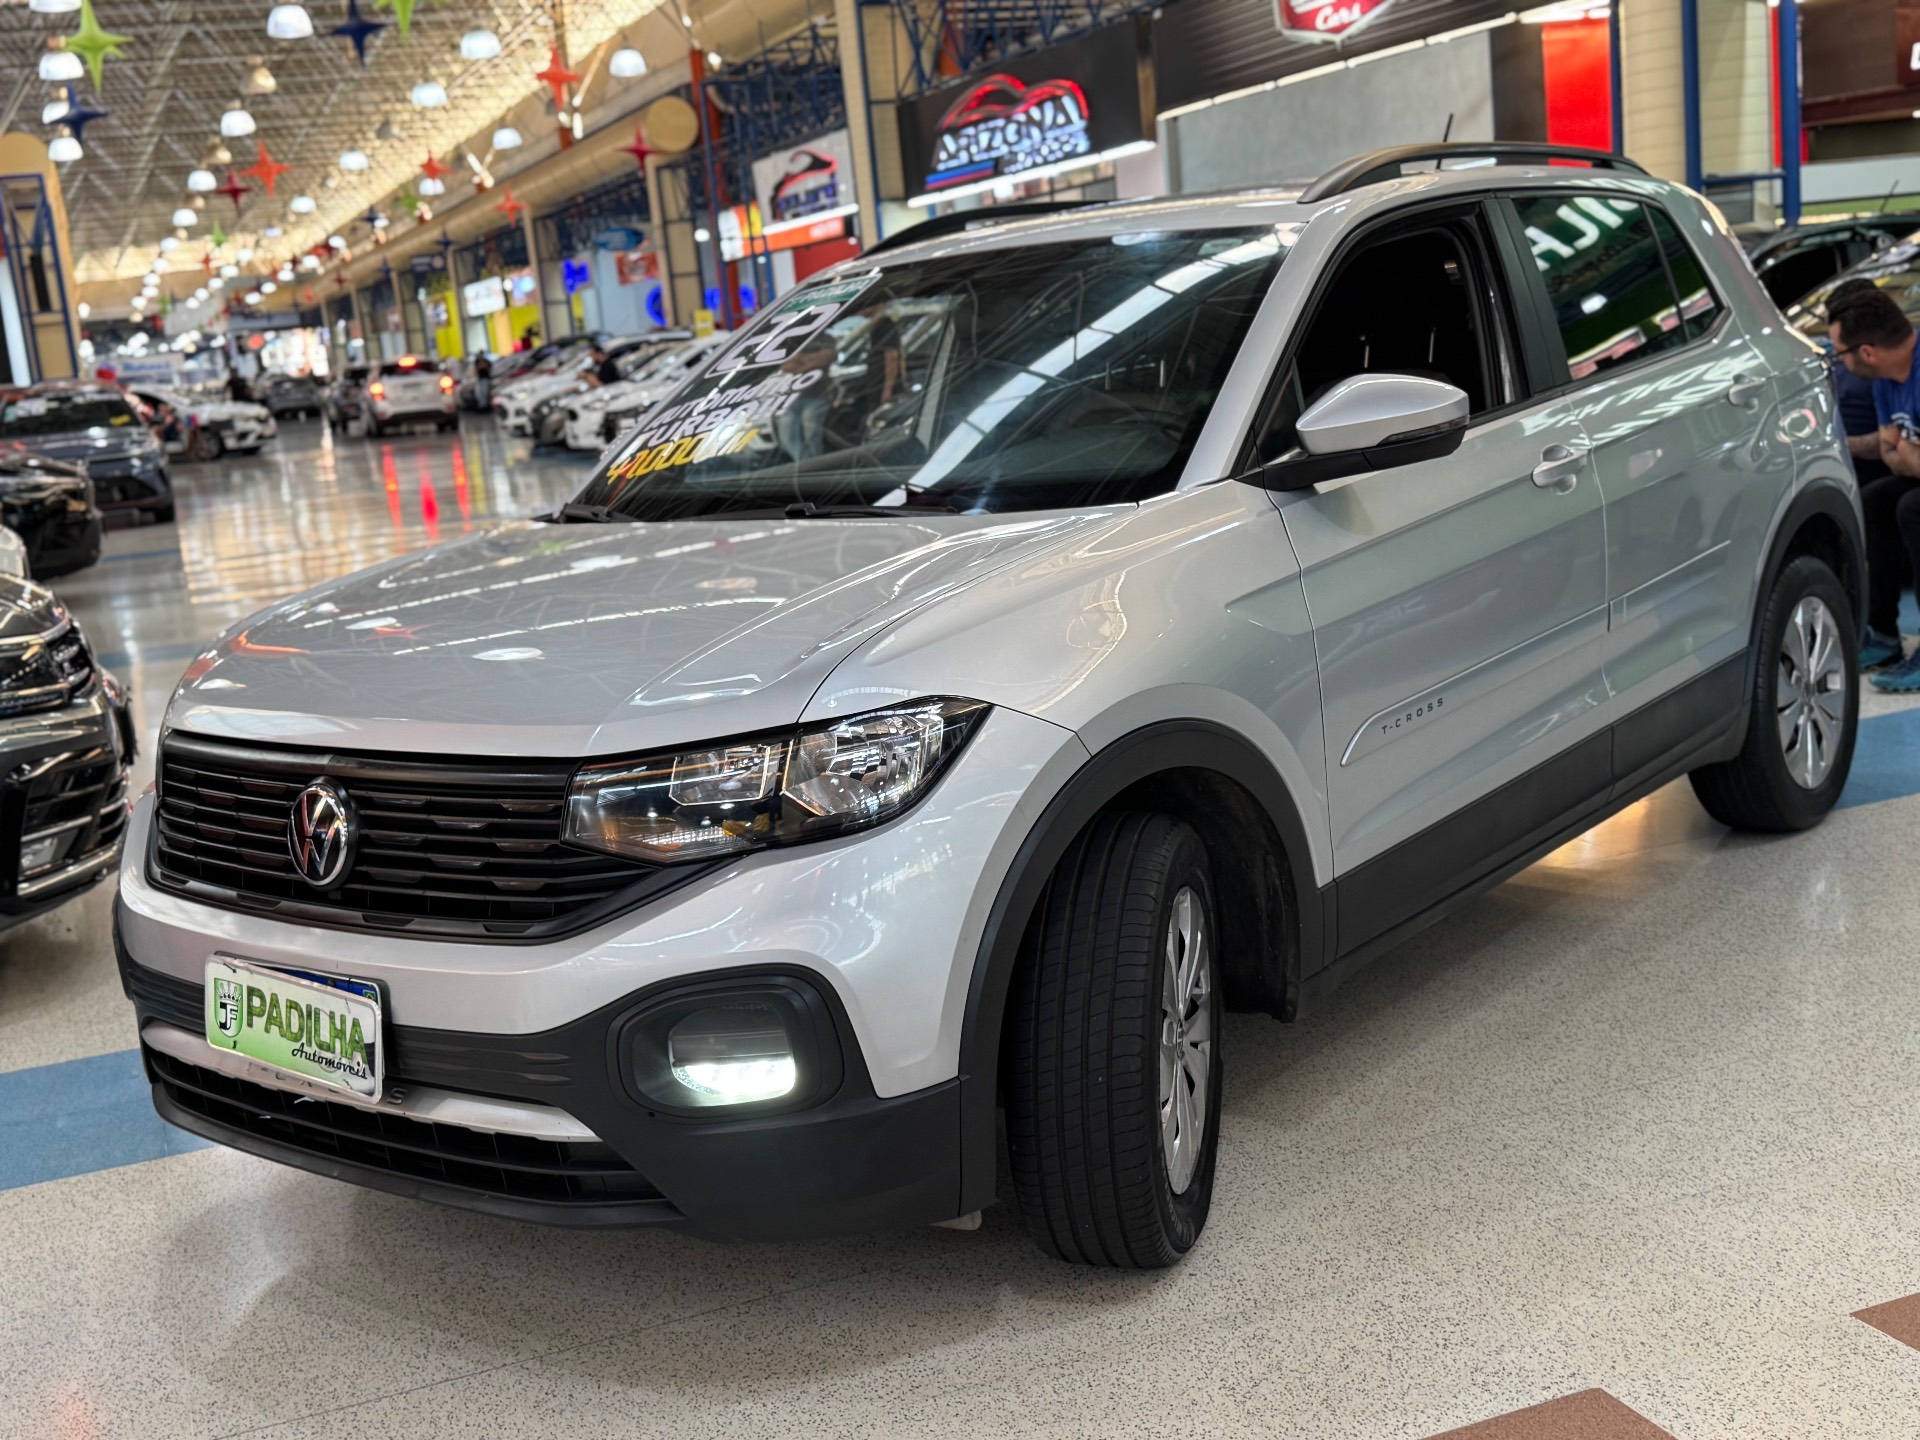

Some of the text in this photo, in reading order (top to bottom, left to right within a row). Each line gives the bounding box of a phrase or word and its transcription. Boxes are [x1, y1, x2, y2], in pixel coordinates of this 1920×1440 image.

[932, 95, 1087, 172] ARIZONA
[715, 302, 832, 372] 22
[1381, 697, 1443, 735] T-CROSS
[246, 984, 369, 1065] PADILHA
[291, 1043, 368, 1081] Automóveis
